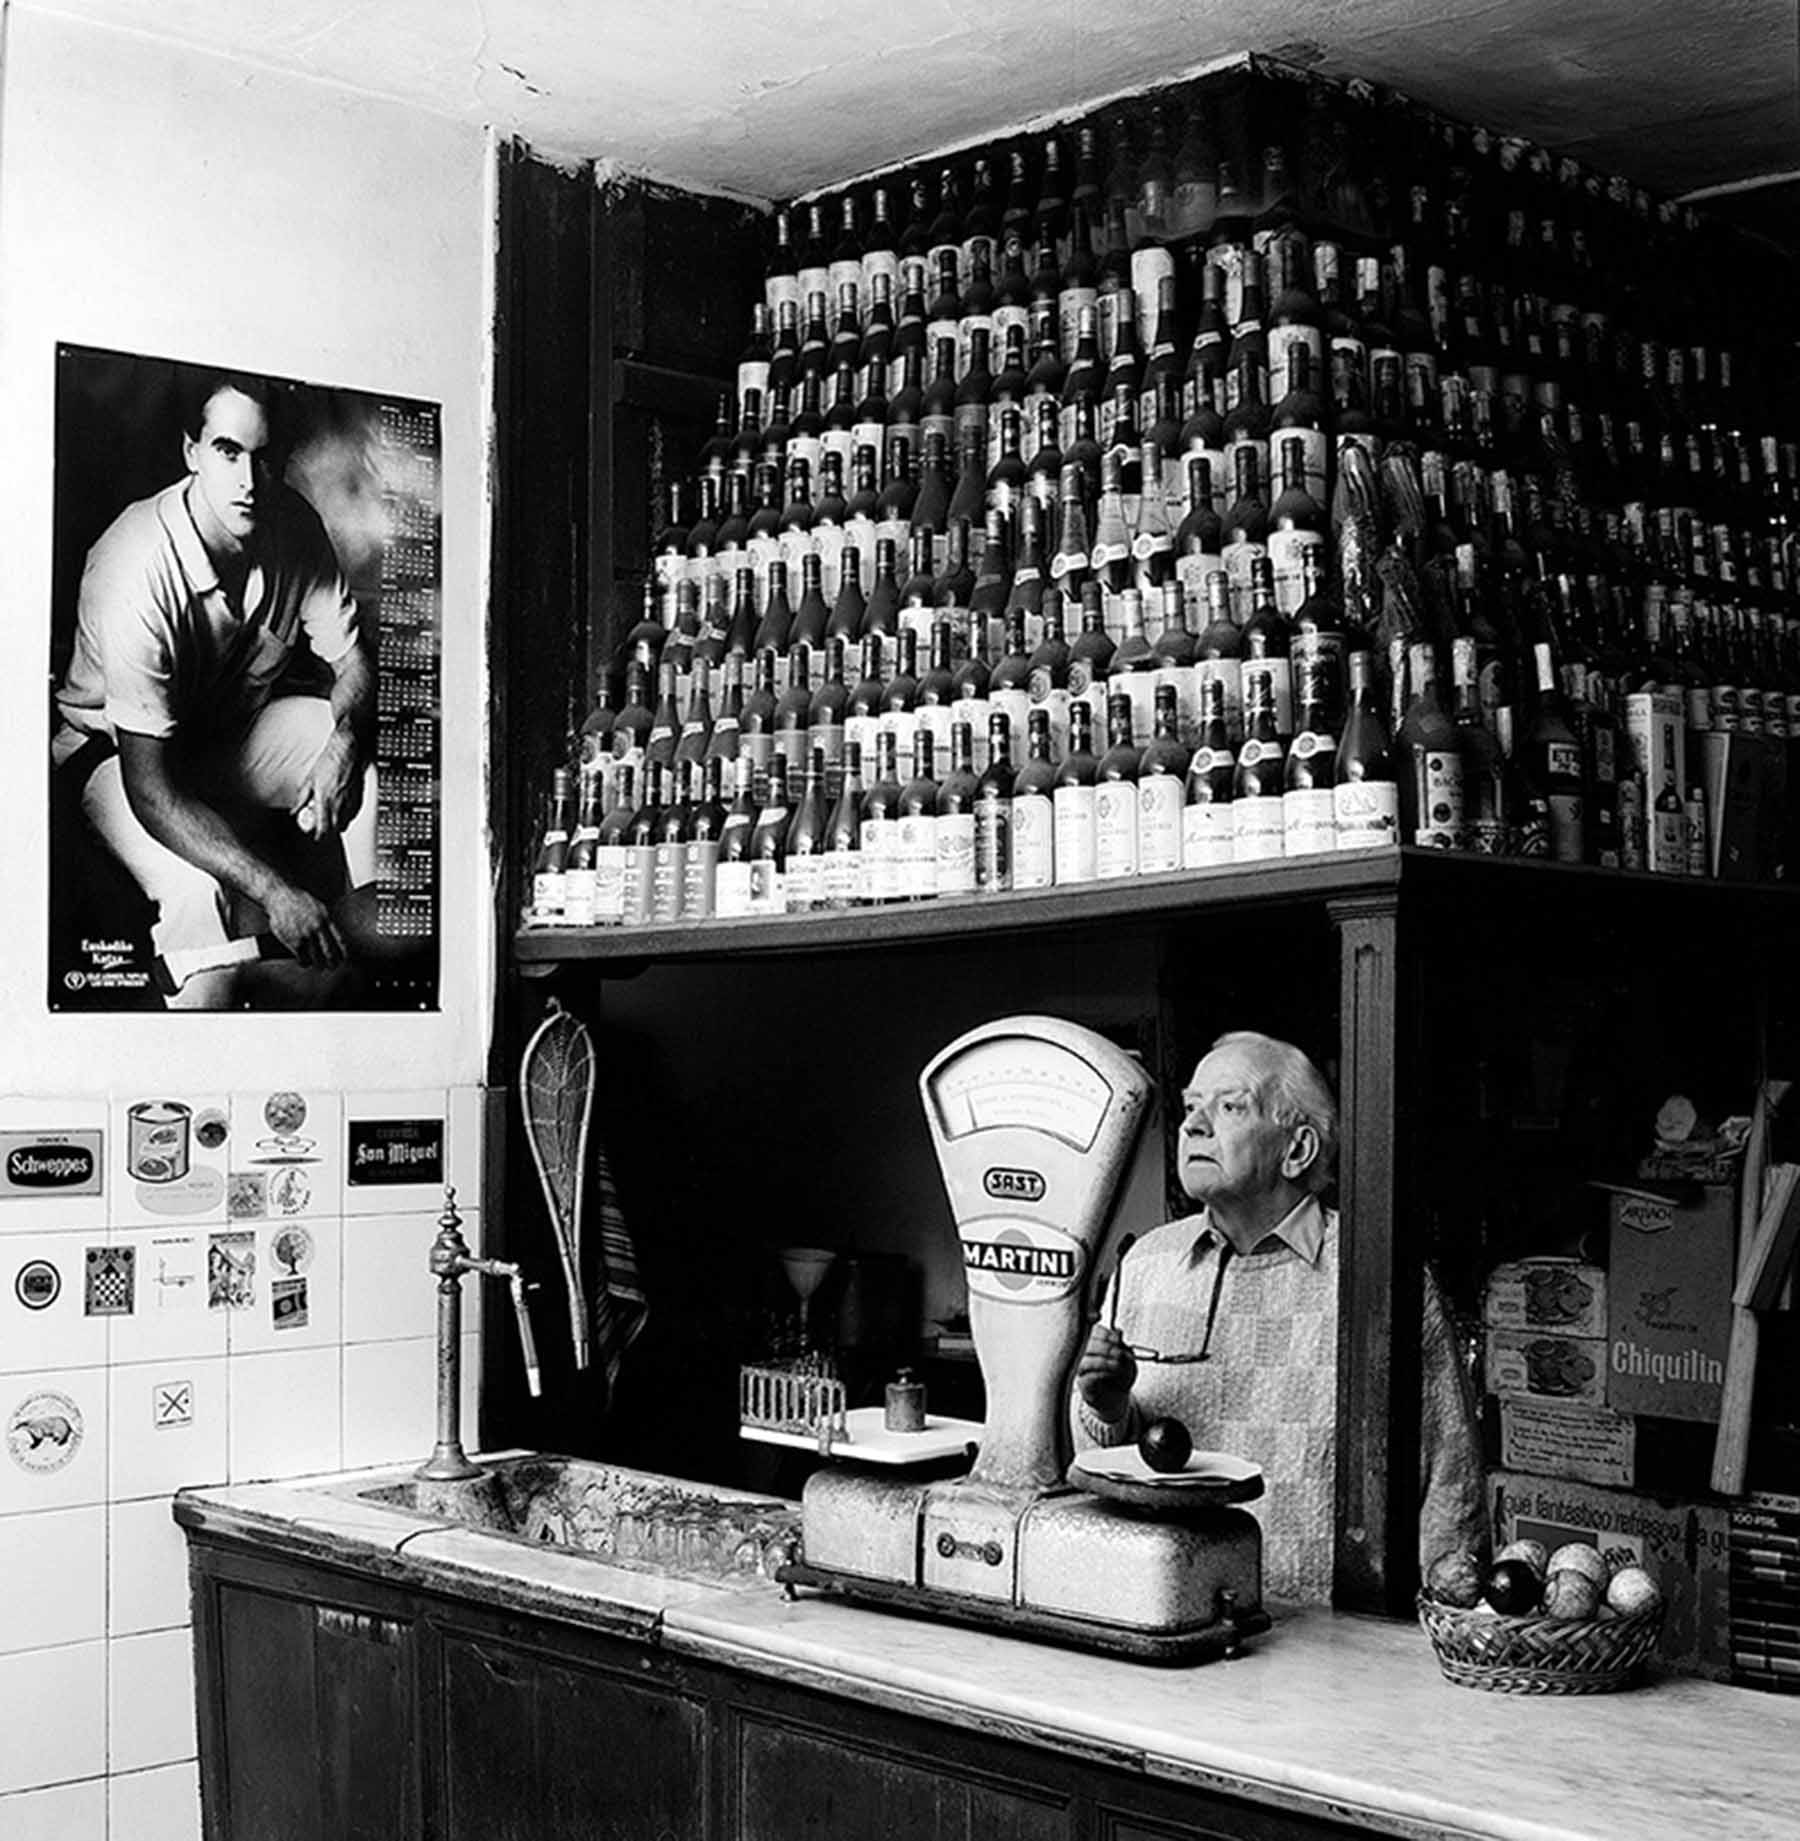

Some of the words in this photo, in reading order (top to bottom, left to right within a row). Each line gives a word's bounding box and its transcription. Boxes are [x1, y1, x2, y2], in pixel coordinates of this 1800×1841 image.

[10, 1151, 88, 1178] Schweppes
[354, 1142, 385, 1167] San
[386, 1138, 438, 1166] Miguel
[962, 1242, 1070, 1276] MARTINI
